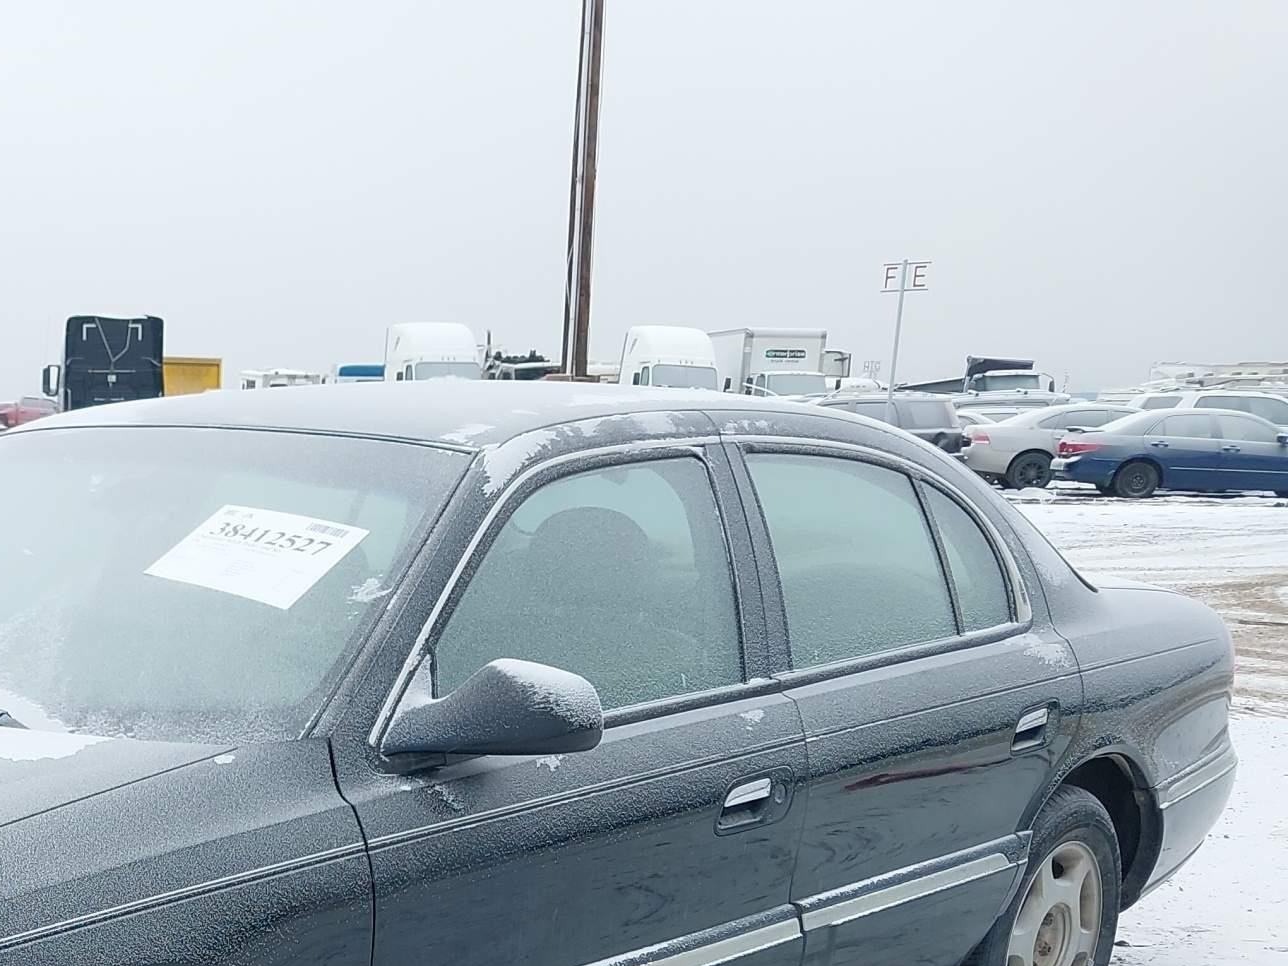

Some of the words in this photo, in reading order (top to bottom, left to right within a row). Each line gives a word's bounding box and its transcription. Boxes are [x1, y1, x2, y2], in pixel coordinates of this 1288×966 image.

[885, 266, 899, 289] F
[913, 264, 928, 287] E
[209, 521, 334, 556] 38412527
